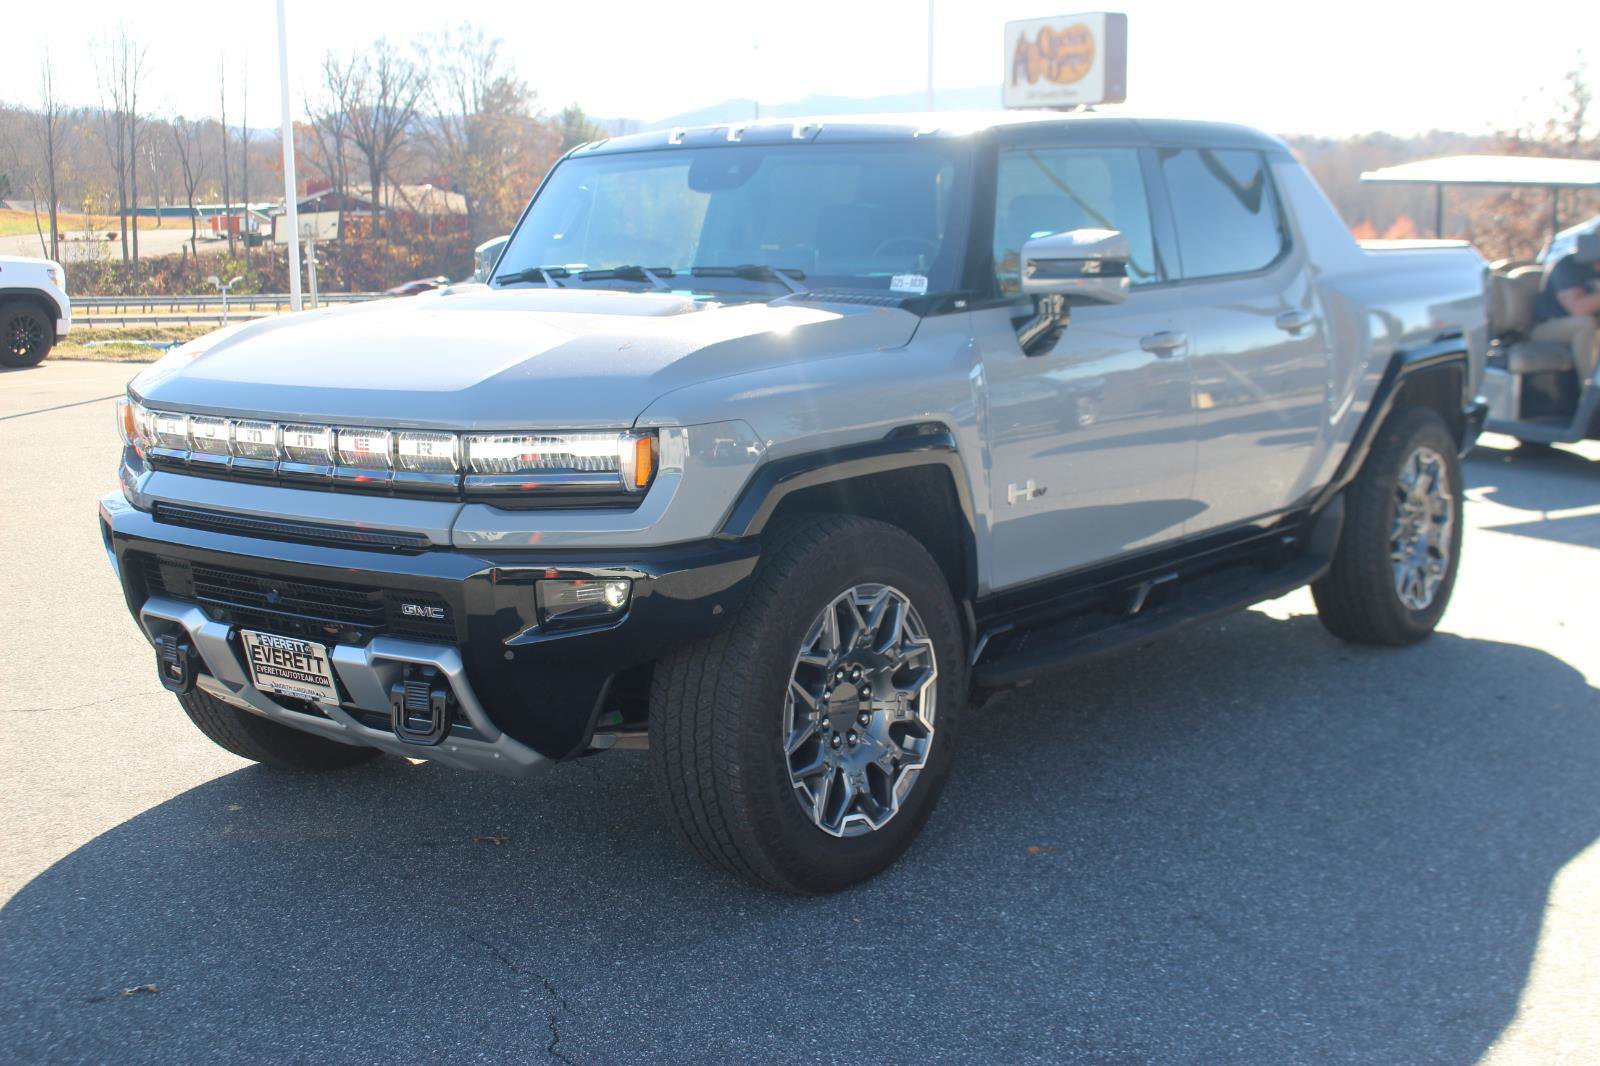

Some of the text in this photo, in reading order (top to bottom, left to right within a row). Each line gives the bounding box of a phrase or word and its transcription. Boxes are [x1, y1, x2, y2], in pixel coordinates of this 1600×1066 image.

[401, 603, 445, 619] GMC
[260, 634, 305, 653] EVERETT
[251, 644, 324, 673] EVERETT
[256, 664, 329, 685] EVERETTAUTOTEAM.COM
